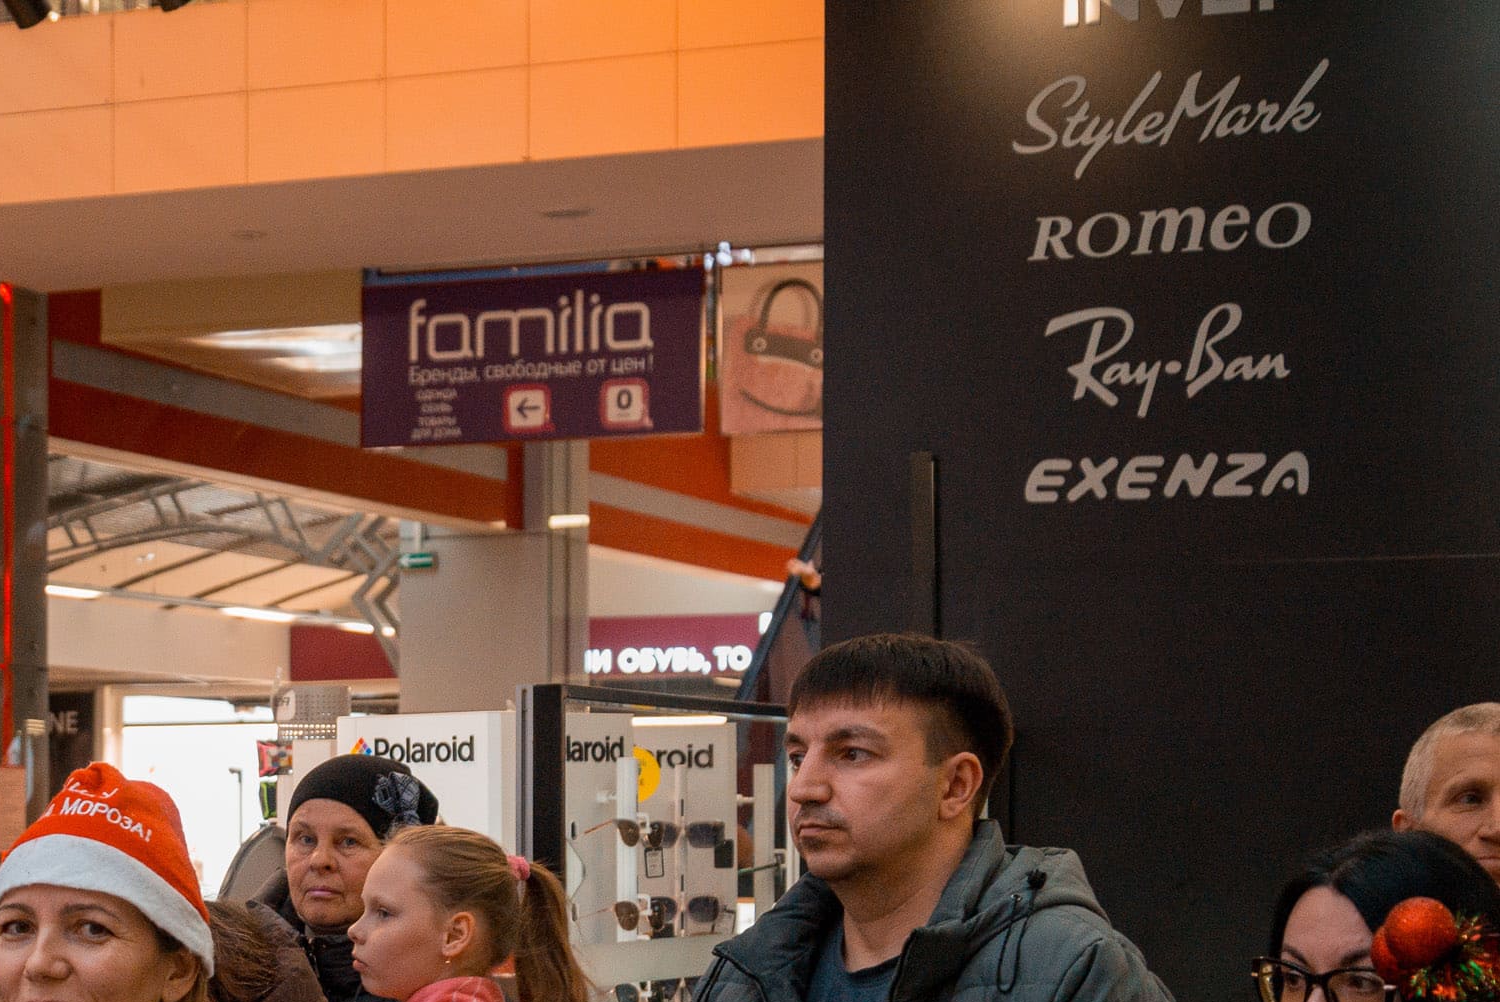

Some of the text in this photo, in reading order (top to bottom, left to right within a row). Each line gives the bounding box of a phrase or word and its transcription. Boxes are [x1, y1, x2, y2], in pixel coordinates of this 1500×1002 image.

[1012, 58, 1330, 180] StyleMark
[409, 289, 655, 362] familia
[484, 358, 582, 381] свободные
[585, 359, 606, 375] от
[1025, 451, 1310, 503] EXENZA
[713, 645, 753, 672] ТО
[374, 735, 475, 764] Polaroid
